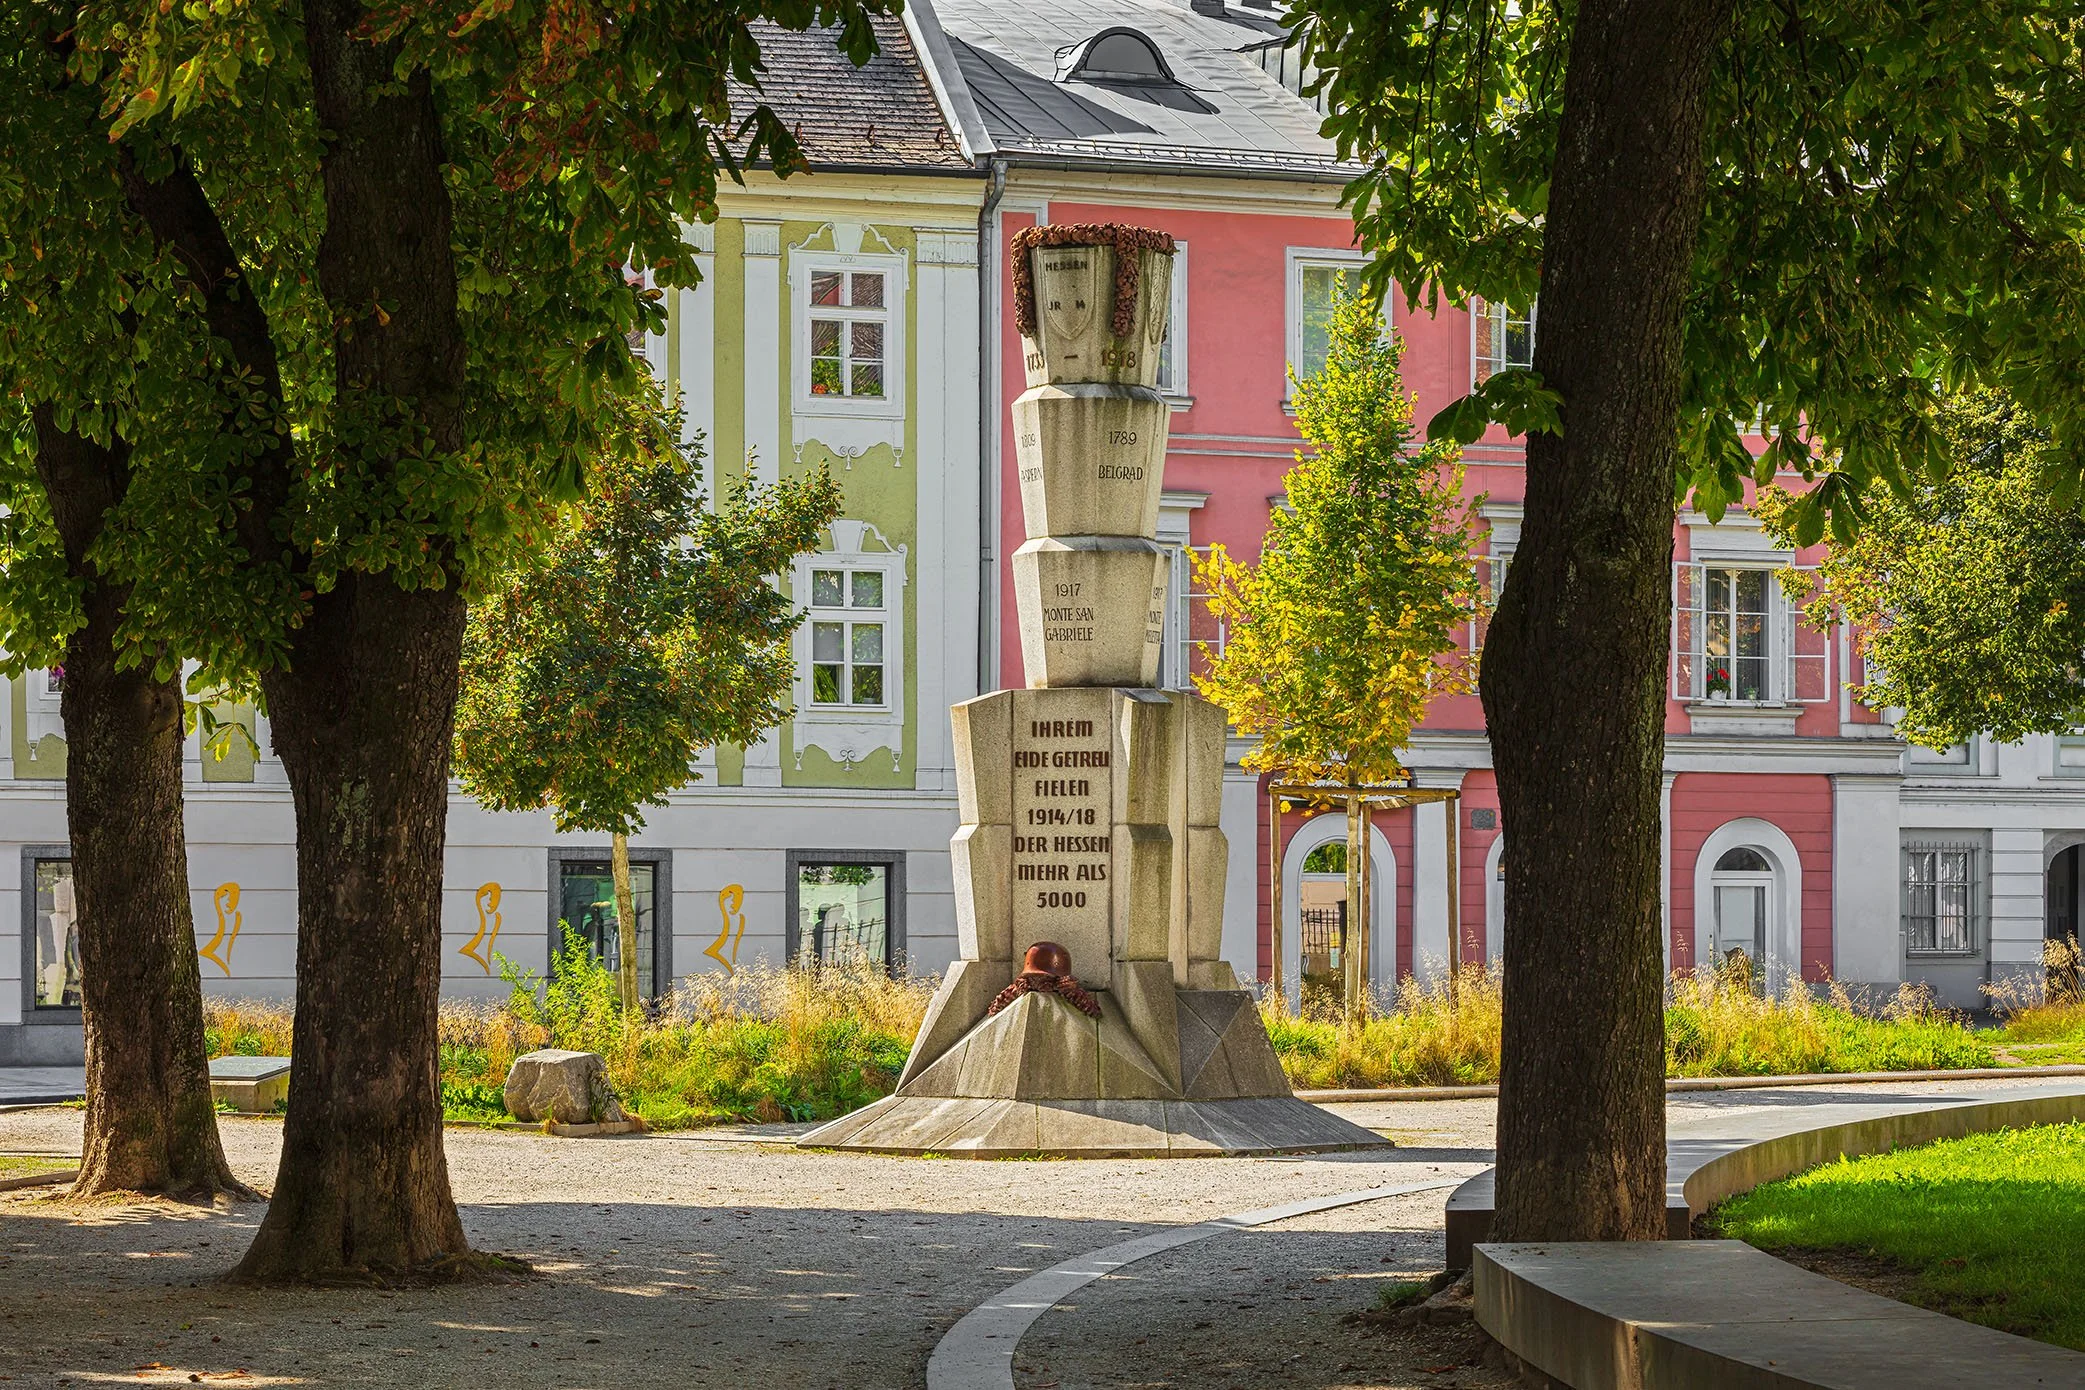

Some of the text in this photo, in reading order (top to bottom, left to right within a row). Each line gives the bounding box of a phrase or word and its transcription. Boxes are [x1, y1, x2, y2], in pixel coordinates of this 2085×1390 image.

[1045, 261, 1088, 272] HESSEN
[1101, 350, 1136, 369] 1918
[1109, 431, 1138, 445] 1789
[1098, 465, 1143, 481] BELGRAD
[1055, 583, 1081, 597] 1917
[1043, 608, 1094, 622] MONTE SAN
[1045, 627, 1094, 642] GABRIELE
[1031, 720, 1093, 738] IHREM
[1014, 751, 1110, 768] EIDE GETREU
[1035, 779, 1089, 797] FIELEN
[1028, 808, 1095, 826] 1914/18
[1014, 836, 1110, 853] DER HESSEN
[1018, 864, 1106, 881] MEHR ALS
[1036, 891, 1086, 908] 5000
